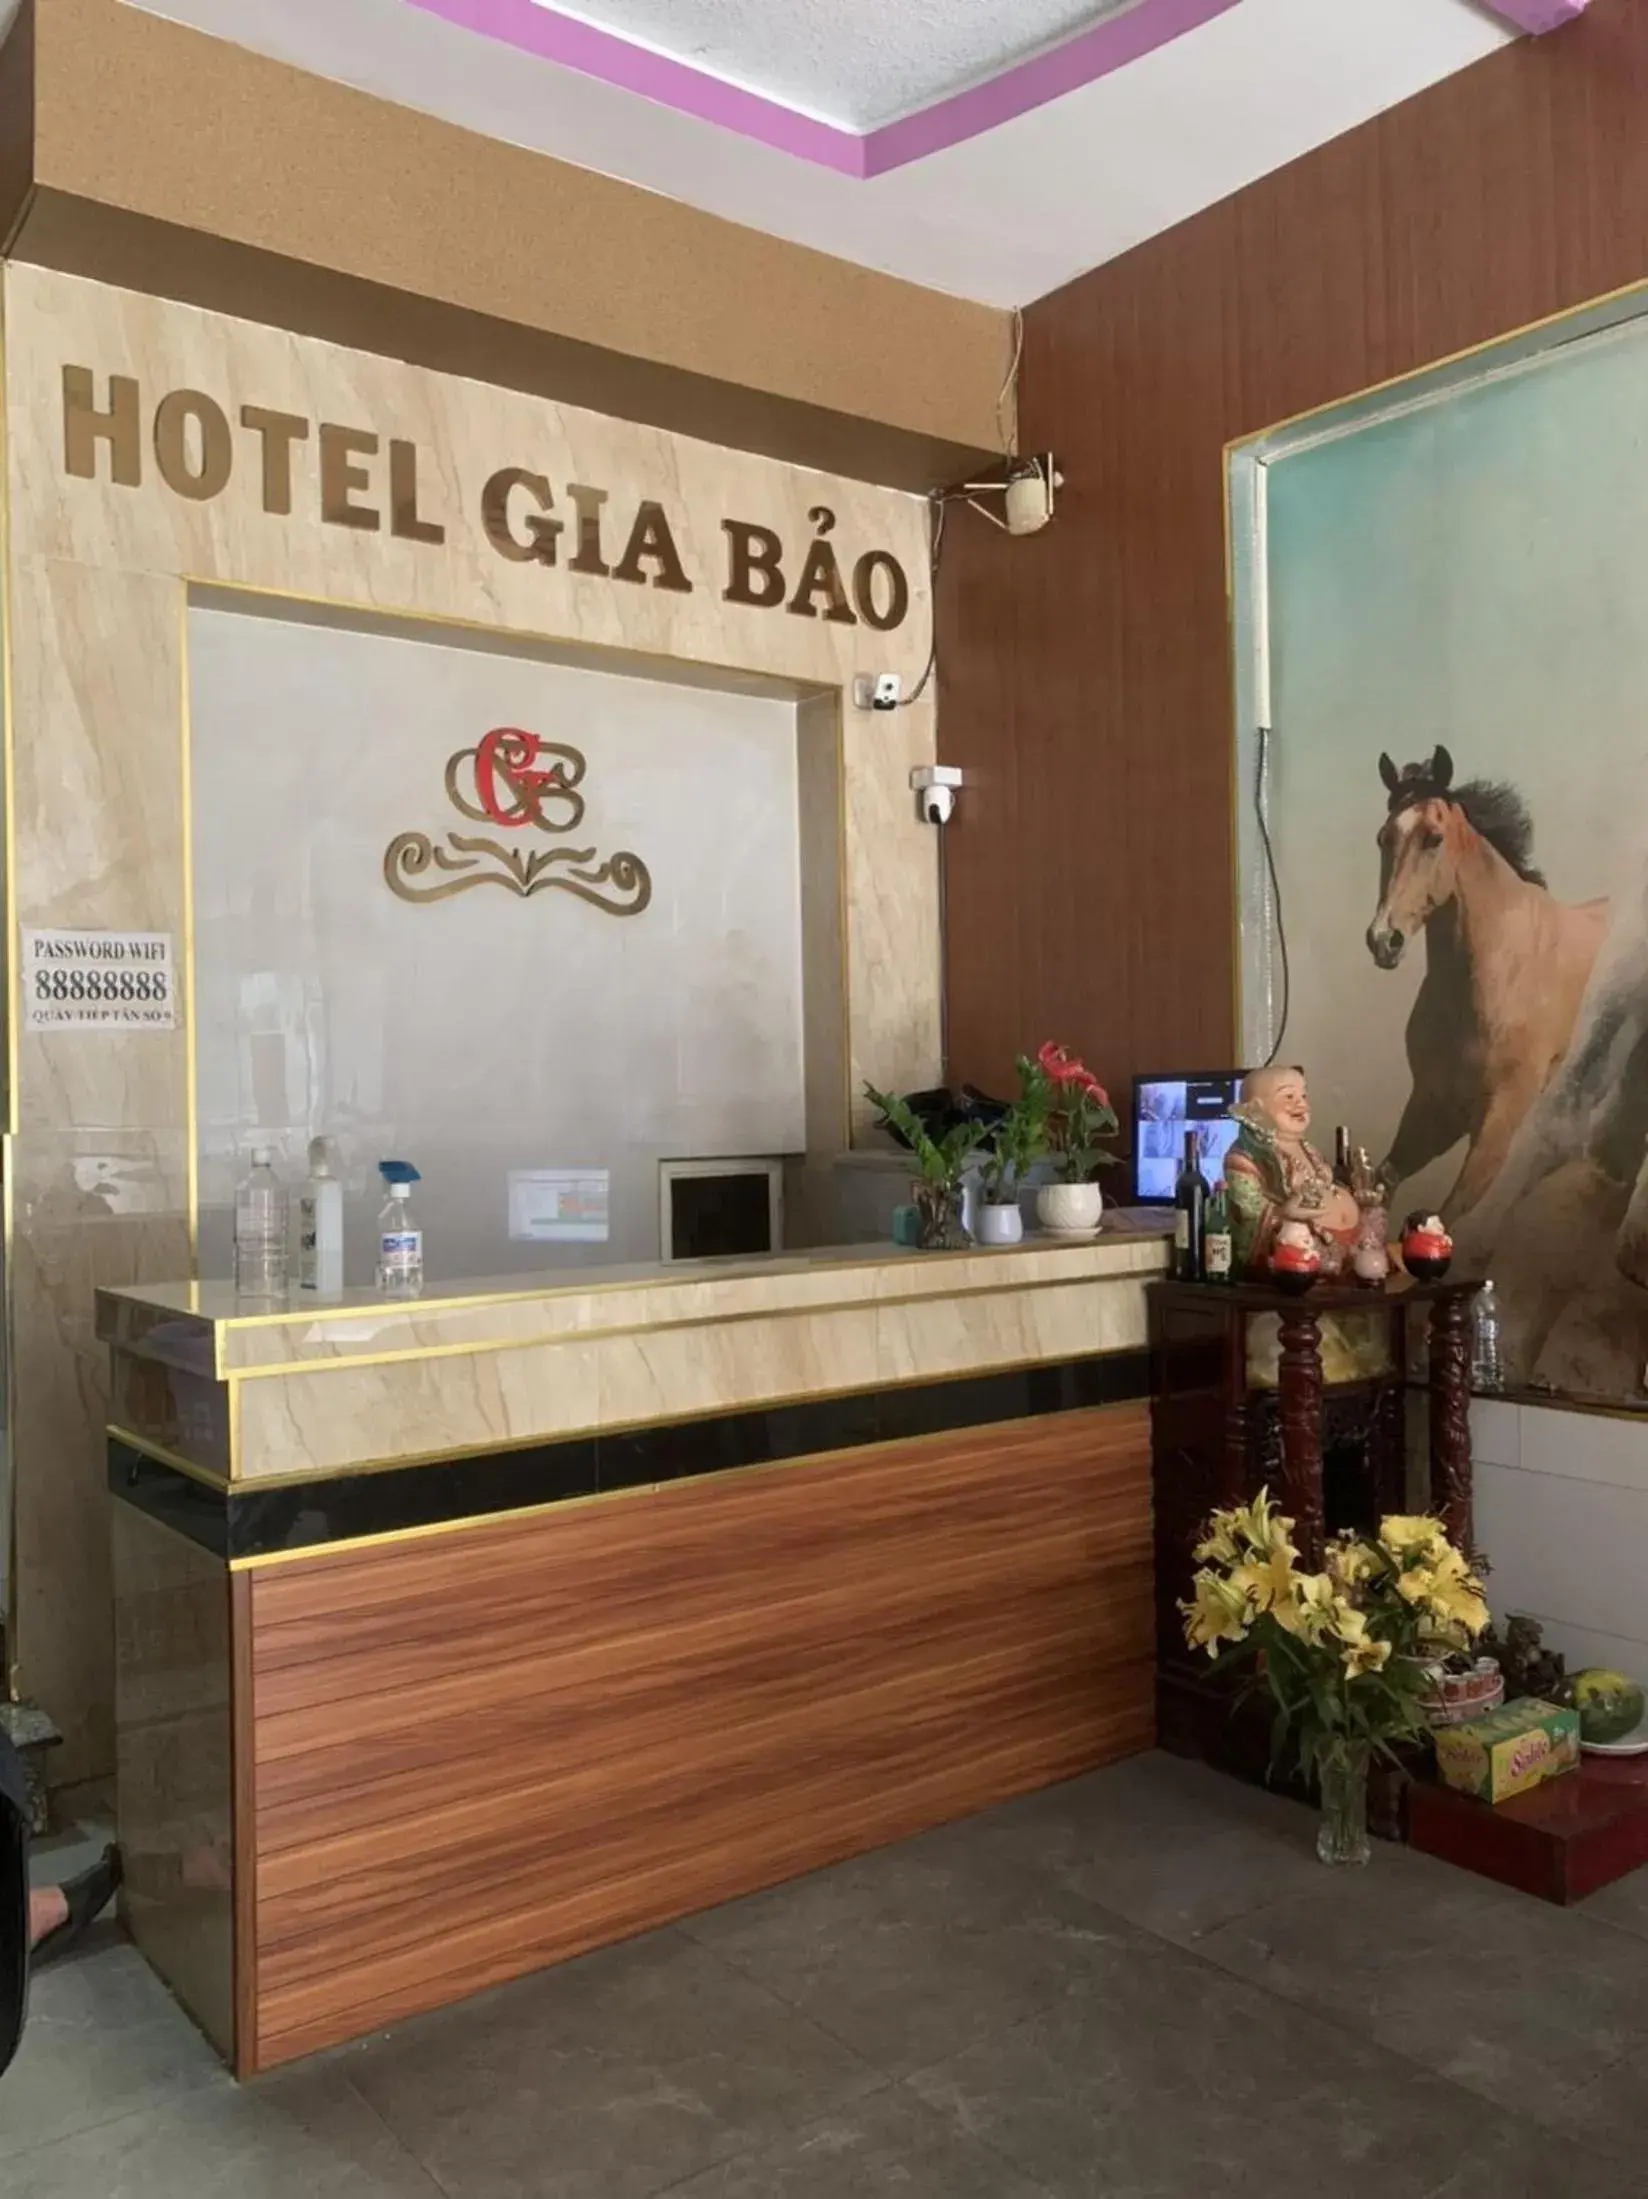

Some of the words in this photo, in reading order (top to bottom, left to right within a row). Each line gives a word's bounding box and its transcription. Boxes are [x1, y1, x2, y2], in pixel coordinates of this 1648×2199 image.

[62, 364, 445, 545] HOTEL
[481, 466, 693, 594] GIA
[722, 506, 909, 632] BẢO
[34, 938, 125, 960] PASSWORD
[127, 941, 166, 961] WIFI
[35, 968, 167, 1001] 88888888
